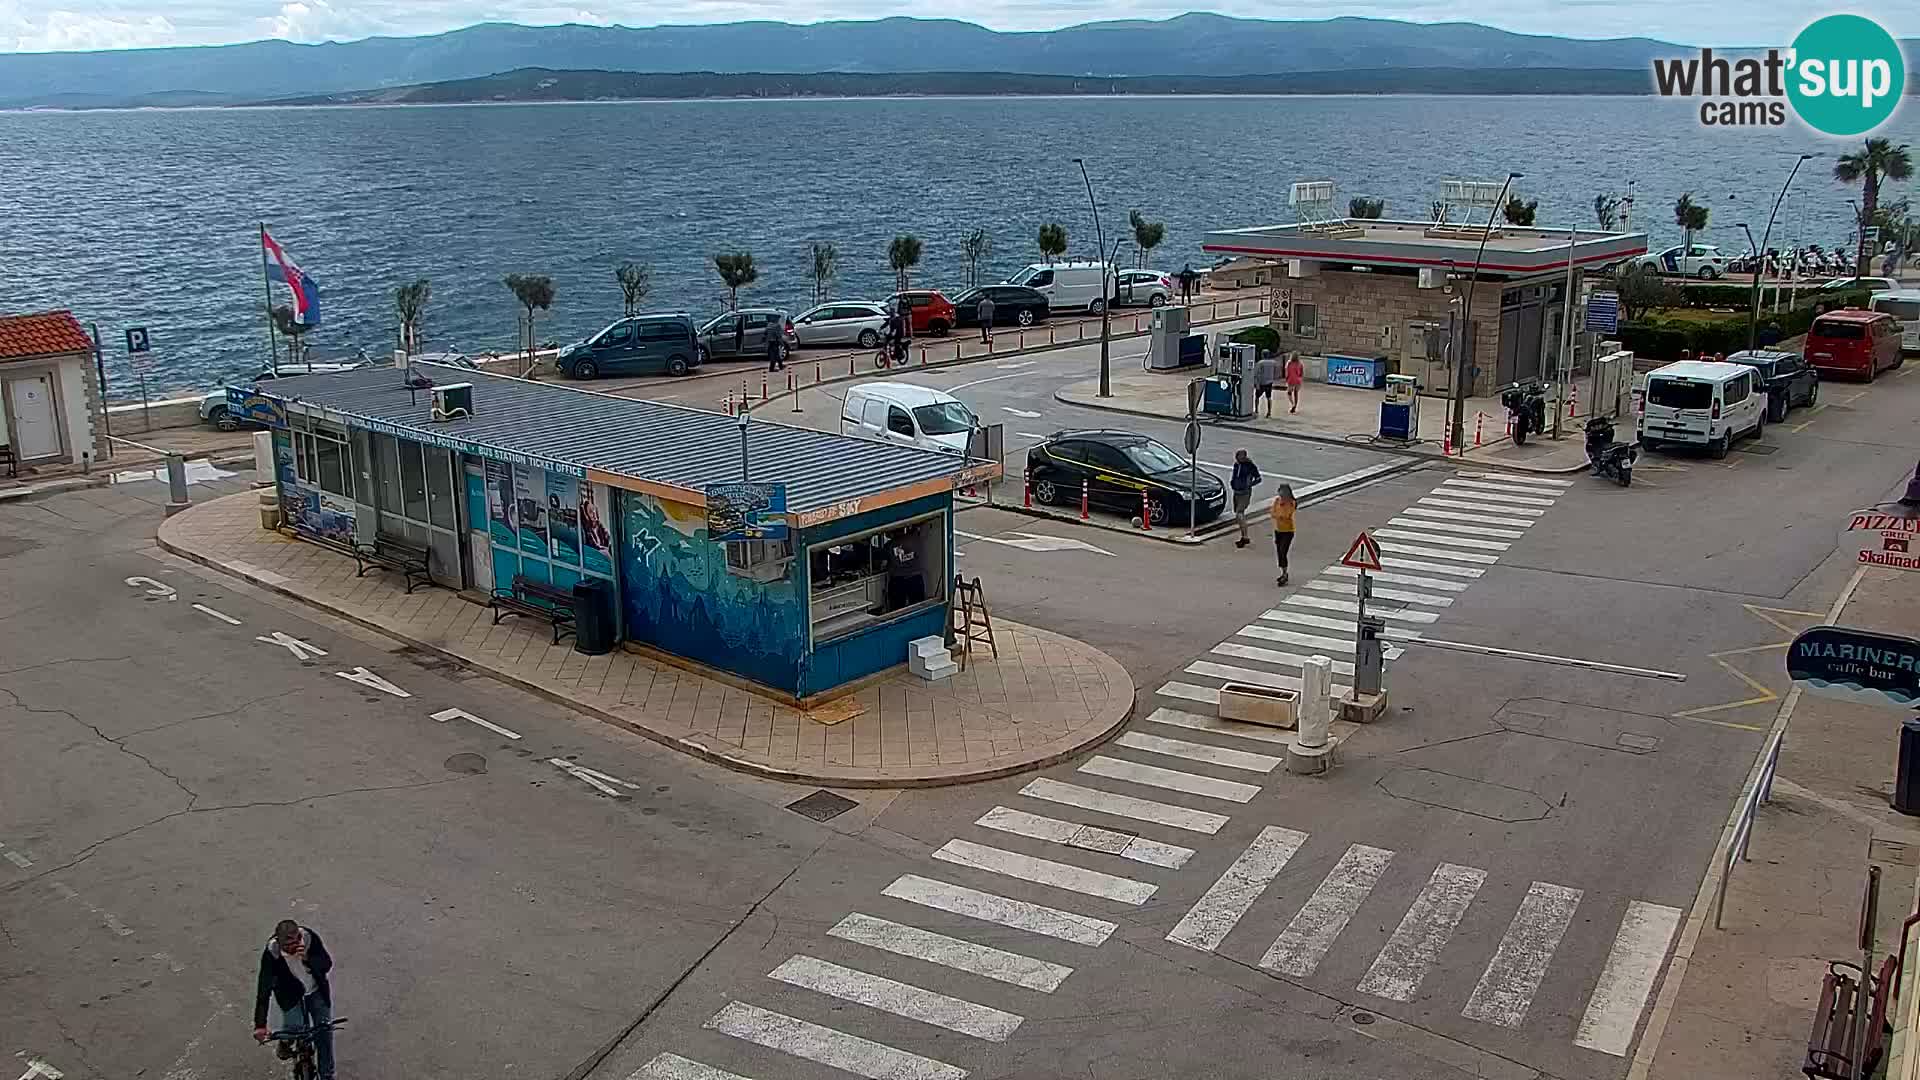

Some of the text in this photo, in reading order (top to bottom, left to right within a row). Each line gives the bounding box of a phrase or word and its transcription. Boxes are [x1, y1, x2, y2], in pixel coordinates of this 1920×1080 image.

[131, 331, 143, 349] P
[437, 437, 468, 452] POSTAJA
[479, 446, 493, 458] BUS
[494, 449, 527, 465] STATION
[527, 457, 554, 470] TICKET
[556, 462, 582, 477] OFFICE
[1847, 515, 1920, 533] PIZZE
[1880, 531, 1916, 541] GRILL
[1869, 665, 1896, 680] bar
